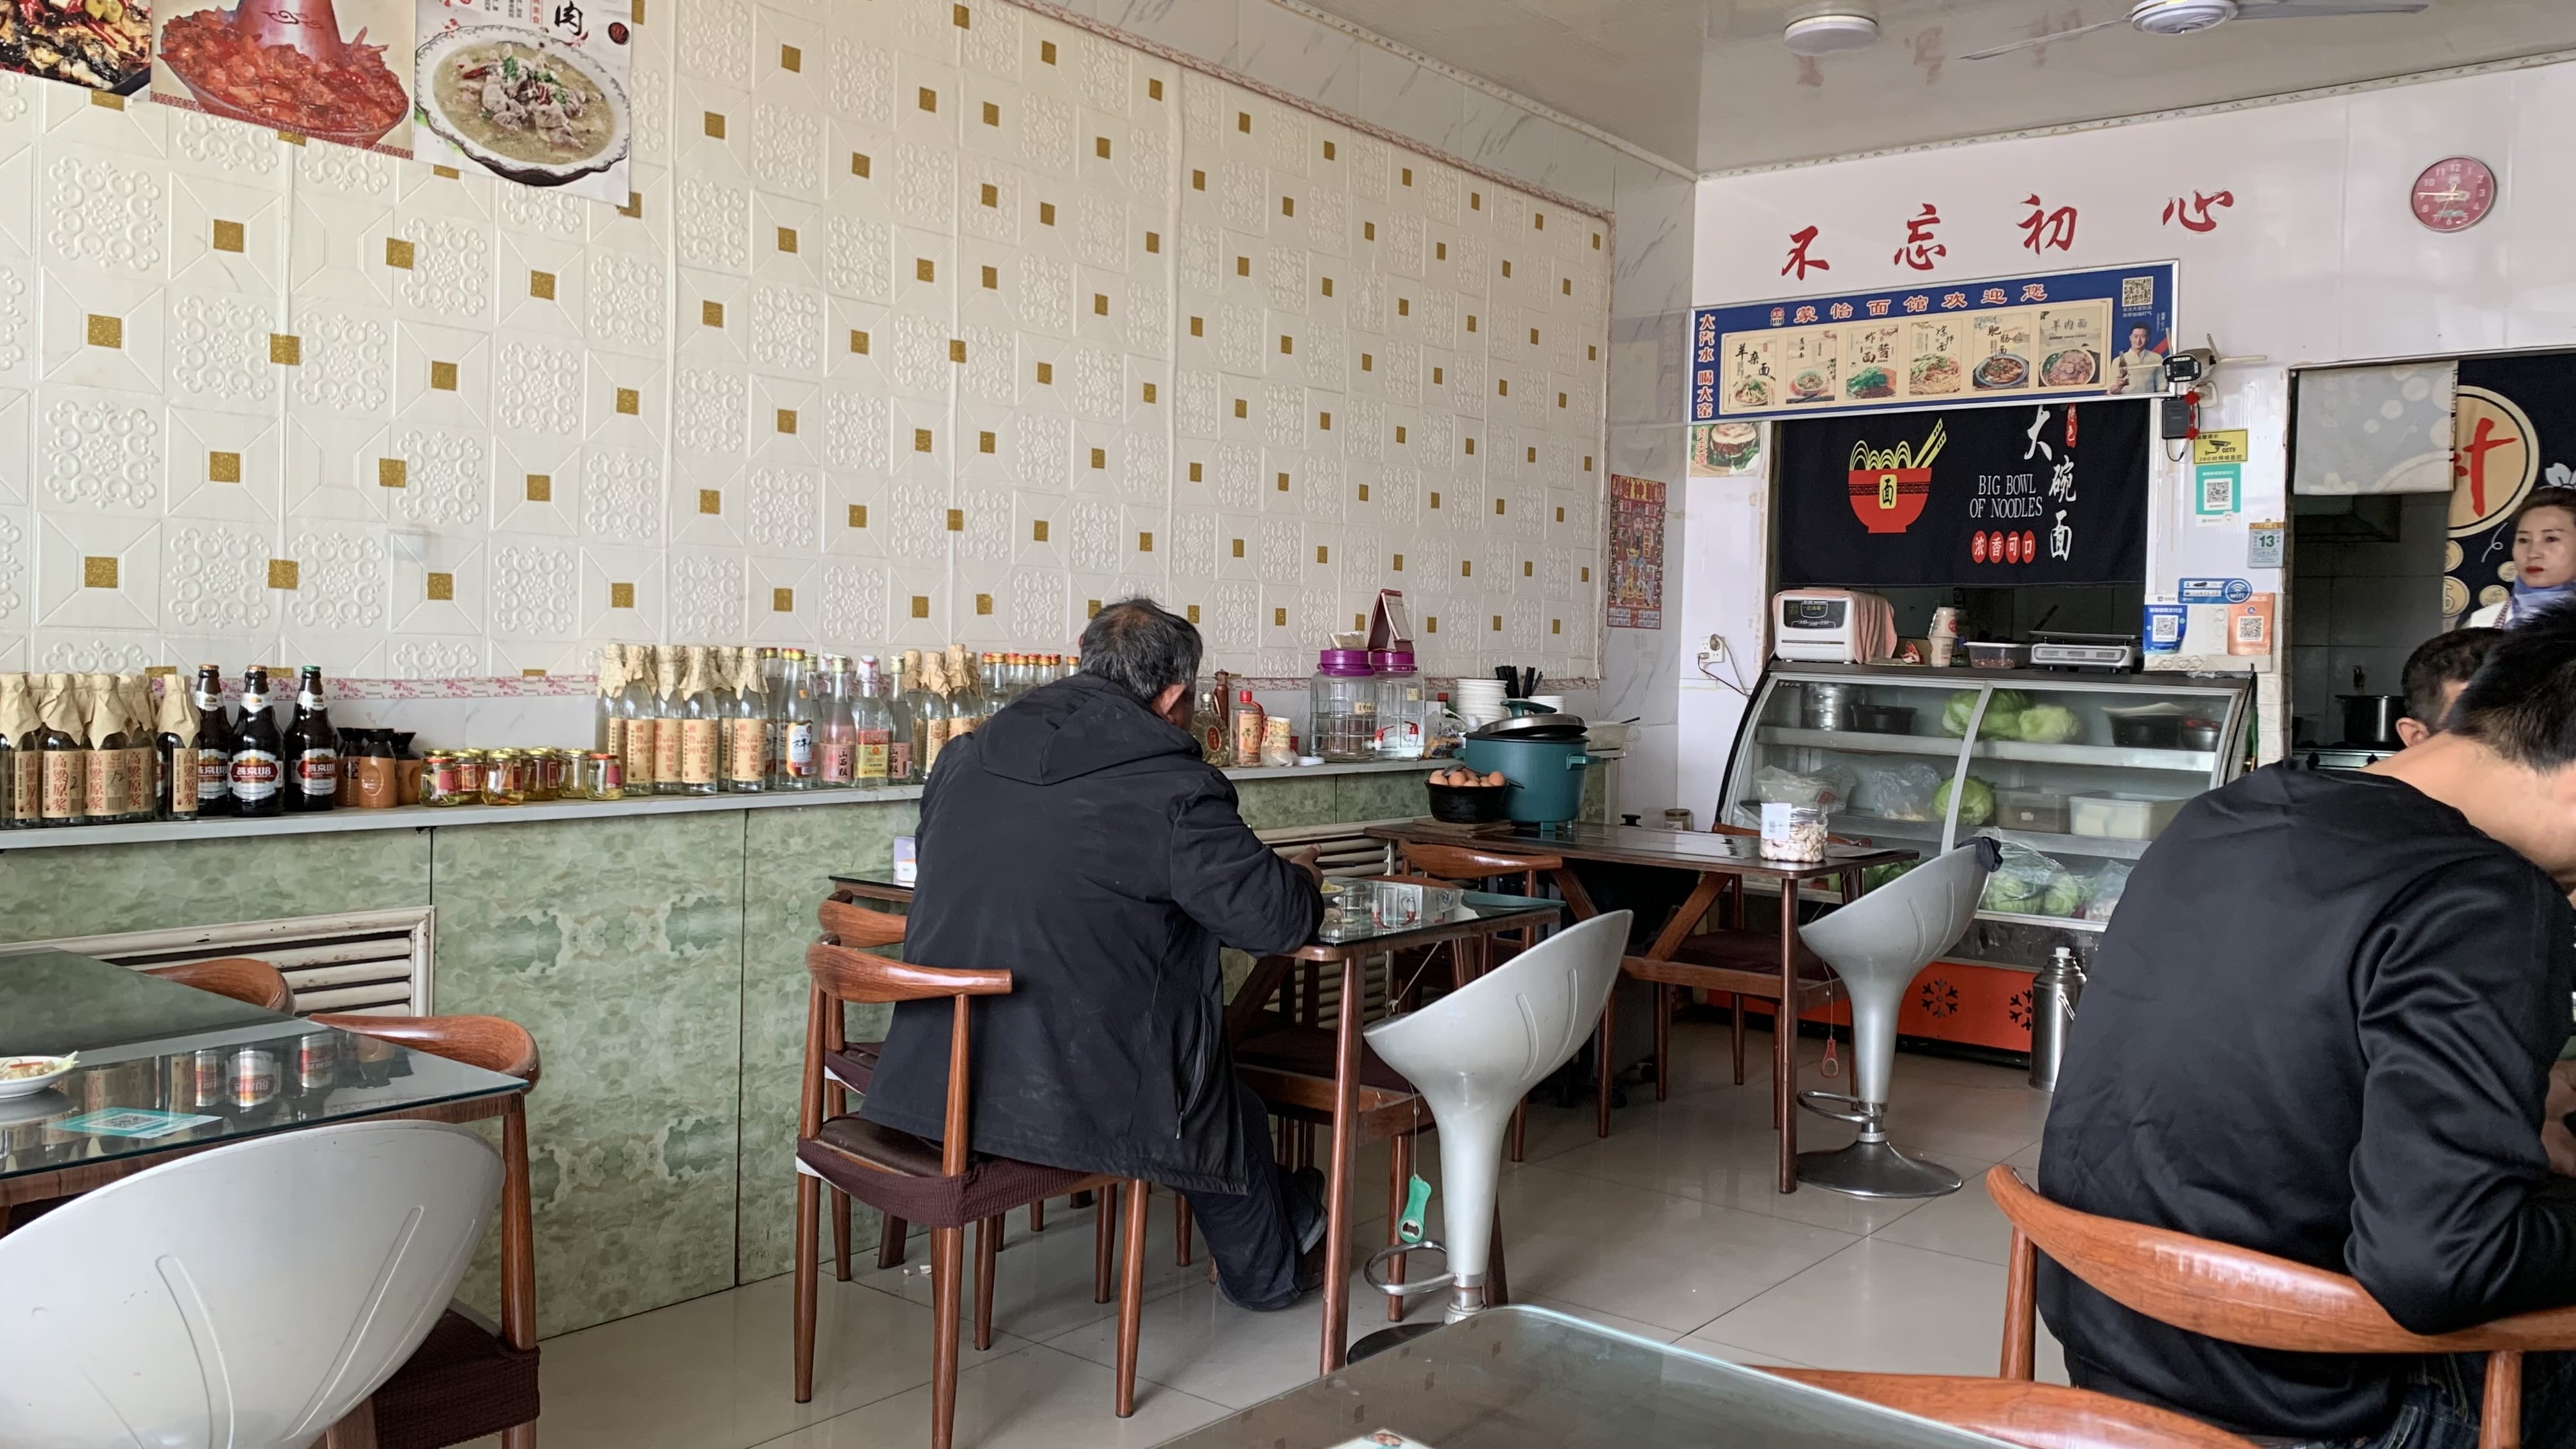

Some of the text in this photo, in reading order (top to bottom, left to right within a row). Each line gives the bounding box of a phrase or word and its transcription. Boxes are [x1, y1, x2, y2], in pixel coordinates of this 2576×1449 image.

[555, 1, 583, 35] 肉
[2436, 168, 2445, 177] 11
[2450, 164, 2461, 172] 12
[2423, 178, 2435, 187] 10
[2477, 175, 2484, 184] 2
[2478, 188, 2486, 197] 3
[2422, 204, 2429, 213] 8
[1793, 283, 2048, 324] 蒙怡面馆欢迎您
[2051, 318, 2087, 331] 羊肉面
[1988, 325, 2011, 355] 肥肠面
[1697, 314, 1716, 419] 大汽水 喝大窑
[1735, 342, 1771, 377] 羊杂面
[1978, 473, 2037, 495] BIG BOWL
[2024, 404, 2078, 562] 大碗面
[1882, 479, 1894, 507] 面
[1969, 496, 2043, 519] OF NOODLES
[1974, 535, 2035, 556] 浓香可口
[2259, 535, 2276, 548] 13
[2230, 592, 2245, 600] wifi
[236, 766, 272, 776] 燕京U8
